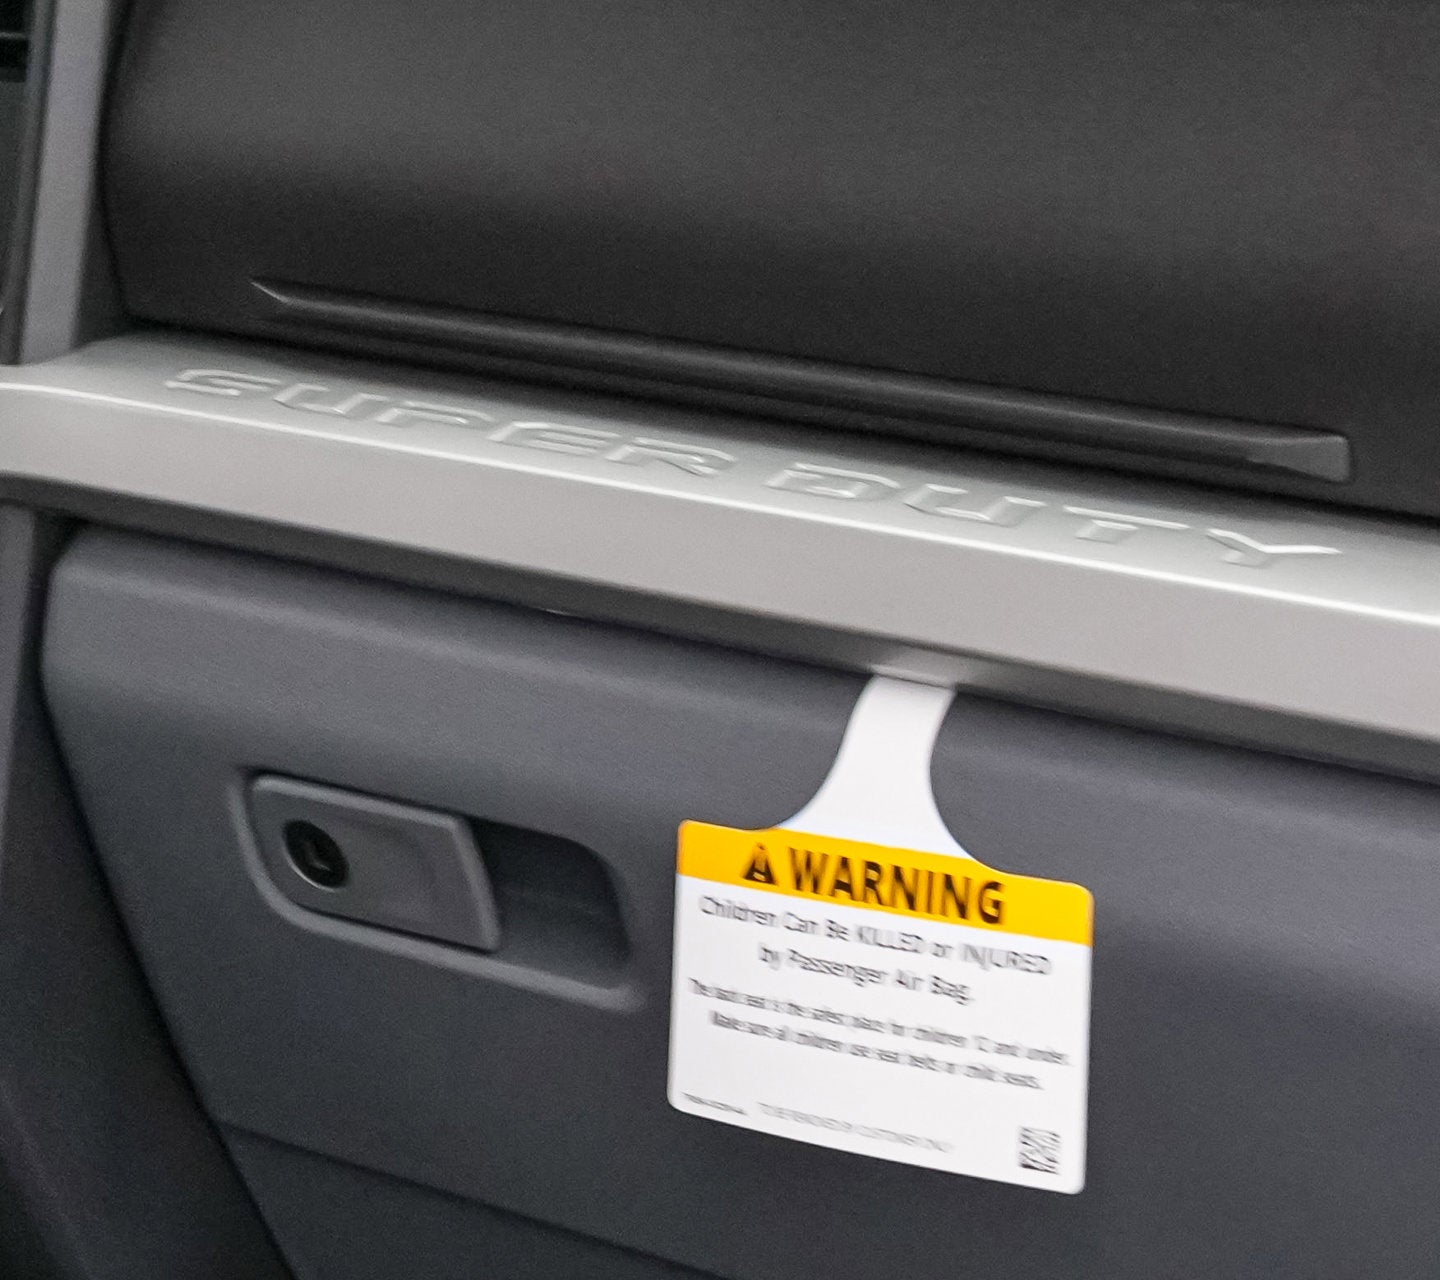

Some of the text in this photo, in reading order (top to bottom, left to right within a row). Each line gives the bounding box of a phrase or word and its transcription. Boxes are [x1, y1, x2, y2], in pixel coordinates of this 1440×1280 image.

[166, 367, 1343, 568] SUPER DUTY
[788, 846, 1007, 925] WARNING
[700, 896, 1051, 974] Children Can Be KILLED or INJURED
[759, 944, 782, 970] by
[786, 949, 889, 987] Passenger
[894, 970, 924, 990] Air
